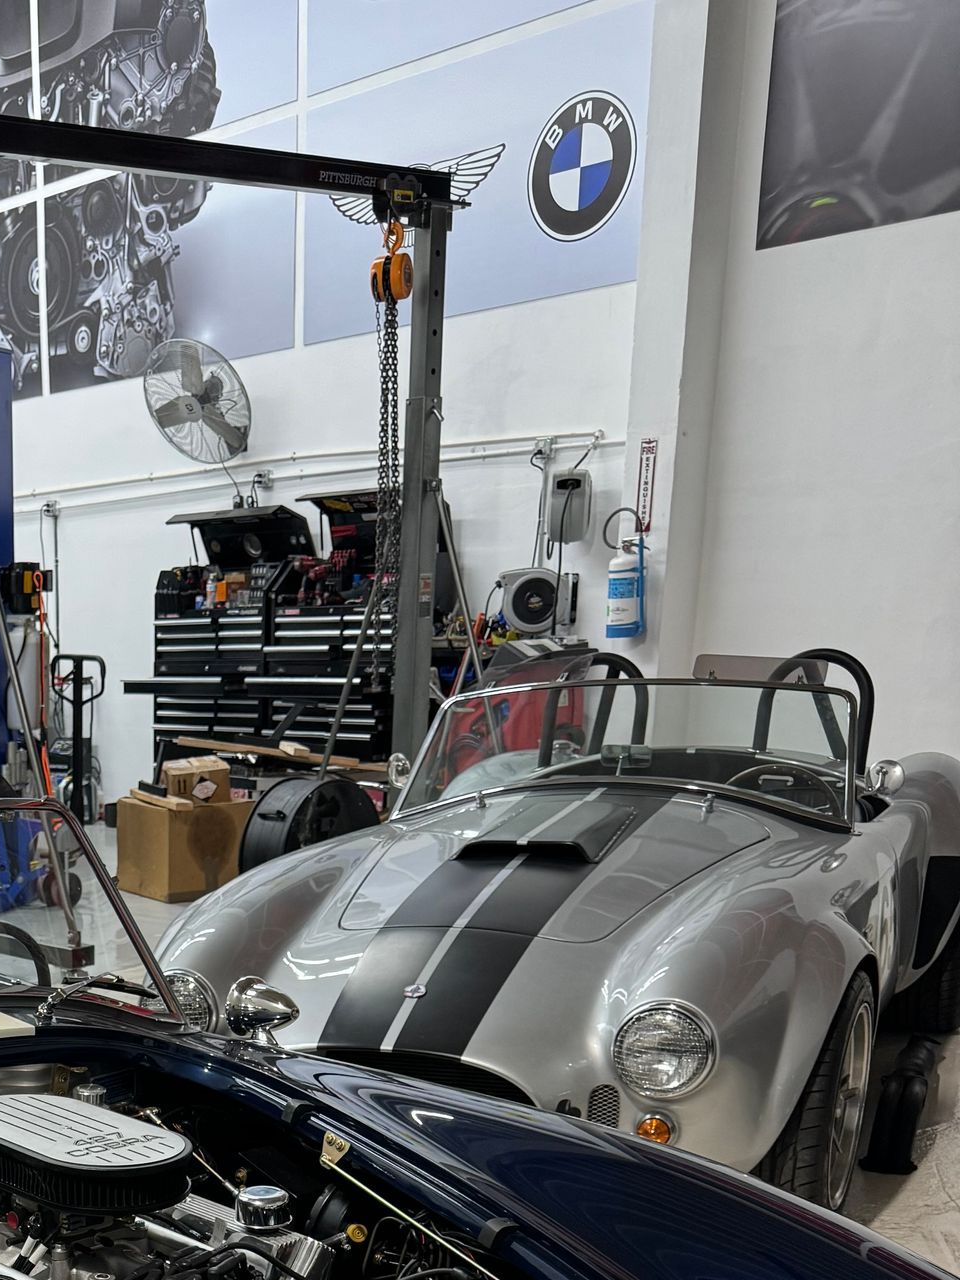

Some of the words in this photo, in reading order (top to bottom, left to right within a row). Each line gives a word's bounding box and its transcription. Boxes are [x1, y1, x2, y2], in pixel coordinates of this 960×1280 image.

[545, 100, 623, 150] BMW
[319, 170, 377, 188] PITTSBURGH
[65, 1134, 167, 1158] COBRA
[74, 1131, 124, 1146] 427
